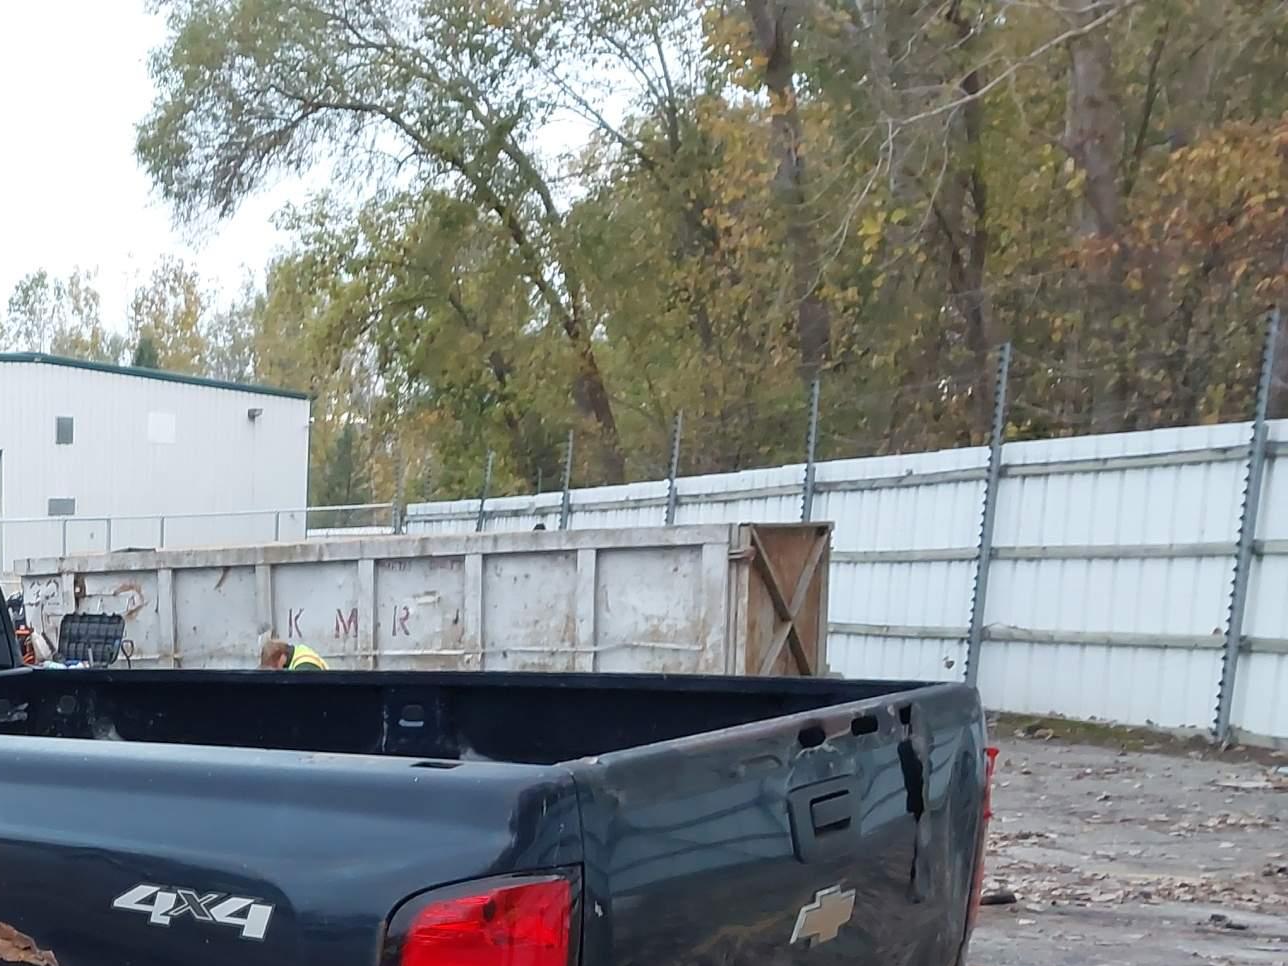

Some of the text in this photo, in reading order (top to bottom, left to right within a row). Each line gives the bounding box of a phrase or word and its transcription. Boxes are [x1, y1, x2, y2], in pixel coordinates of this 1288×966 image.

[288, 605, 410, 638] K M R
